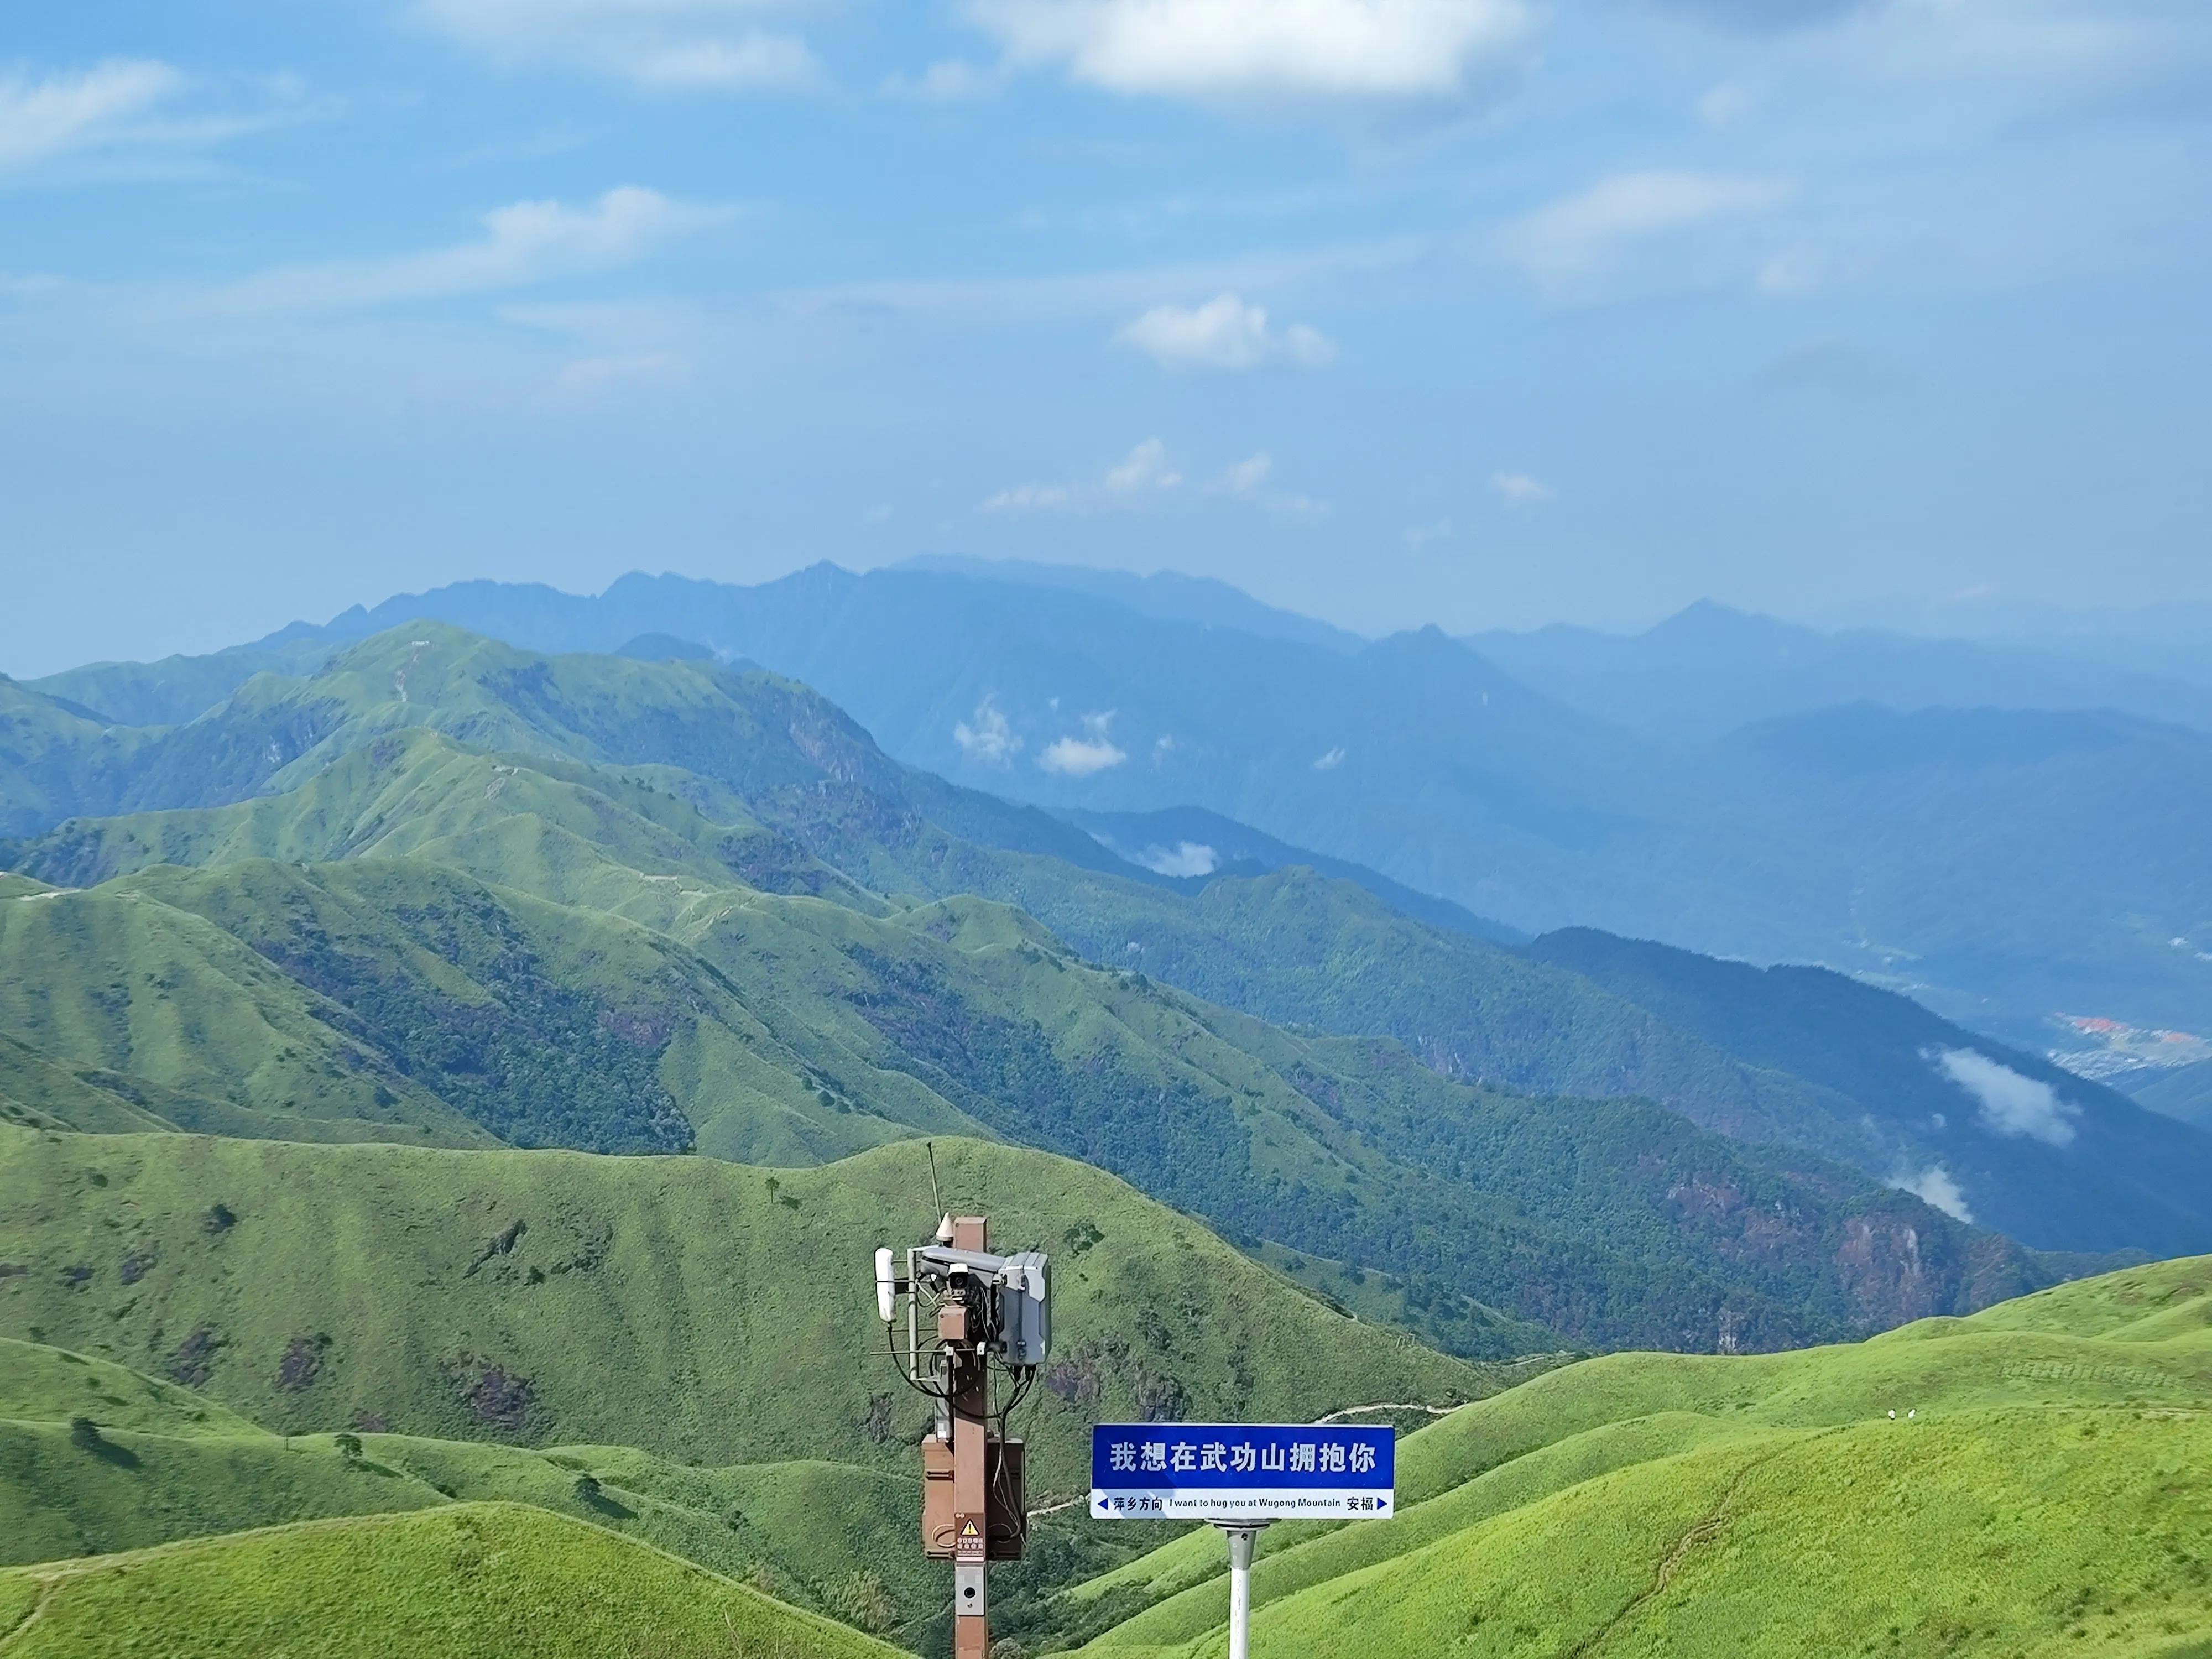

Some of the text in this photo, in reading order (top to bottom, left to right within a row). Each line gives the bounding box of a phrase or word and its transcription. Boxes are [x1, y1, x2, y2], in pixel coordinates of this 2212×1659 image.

[1110, 1441, 1376, 1473] 我想在武功山拥抱你
[1114, 1496, 1163, 1511] 萍乡方向
[1211, 1499, 1227, 1508] hug
[1230, 1500, 1245, 1509] you
[1259, 1499, 1296, 1508] Wugong
[1298, 1499, 1340, 1507] Mountain
[1347, 1496, 1373, 1511] 安福
